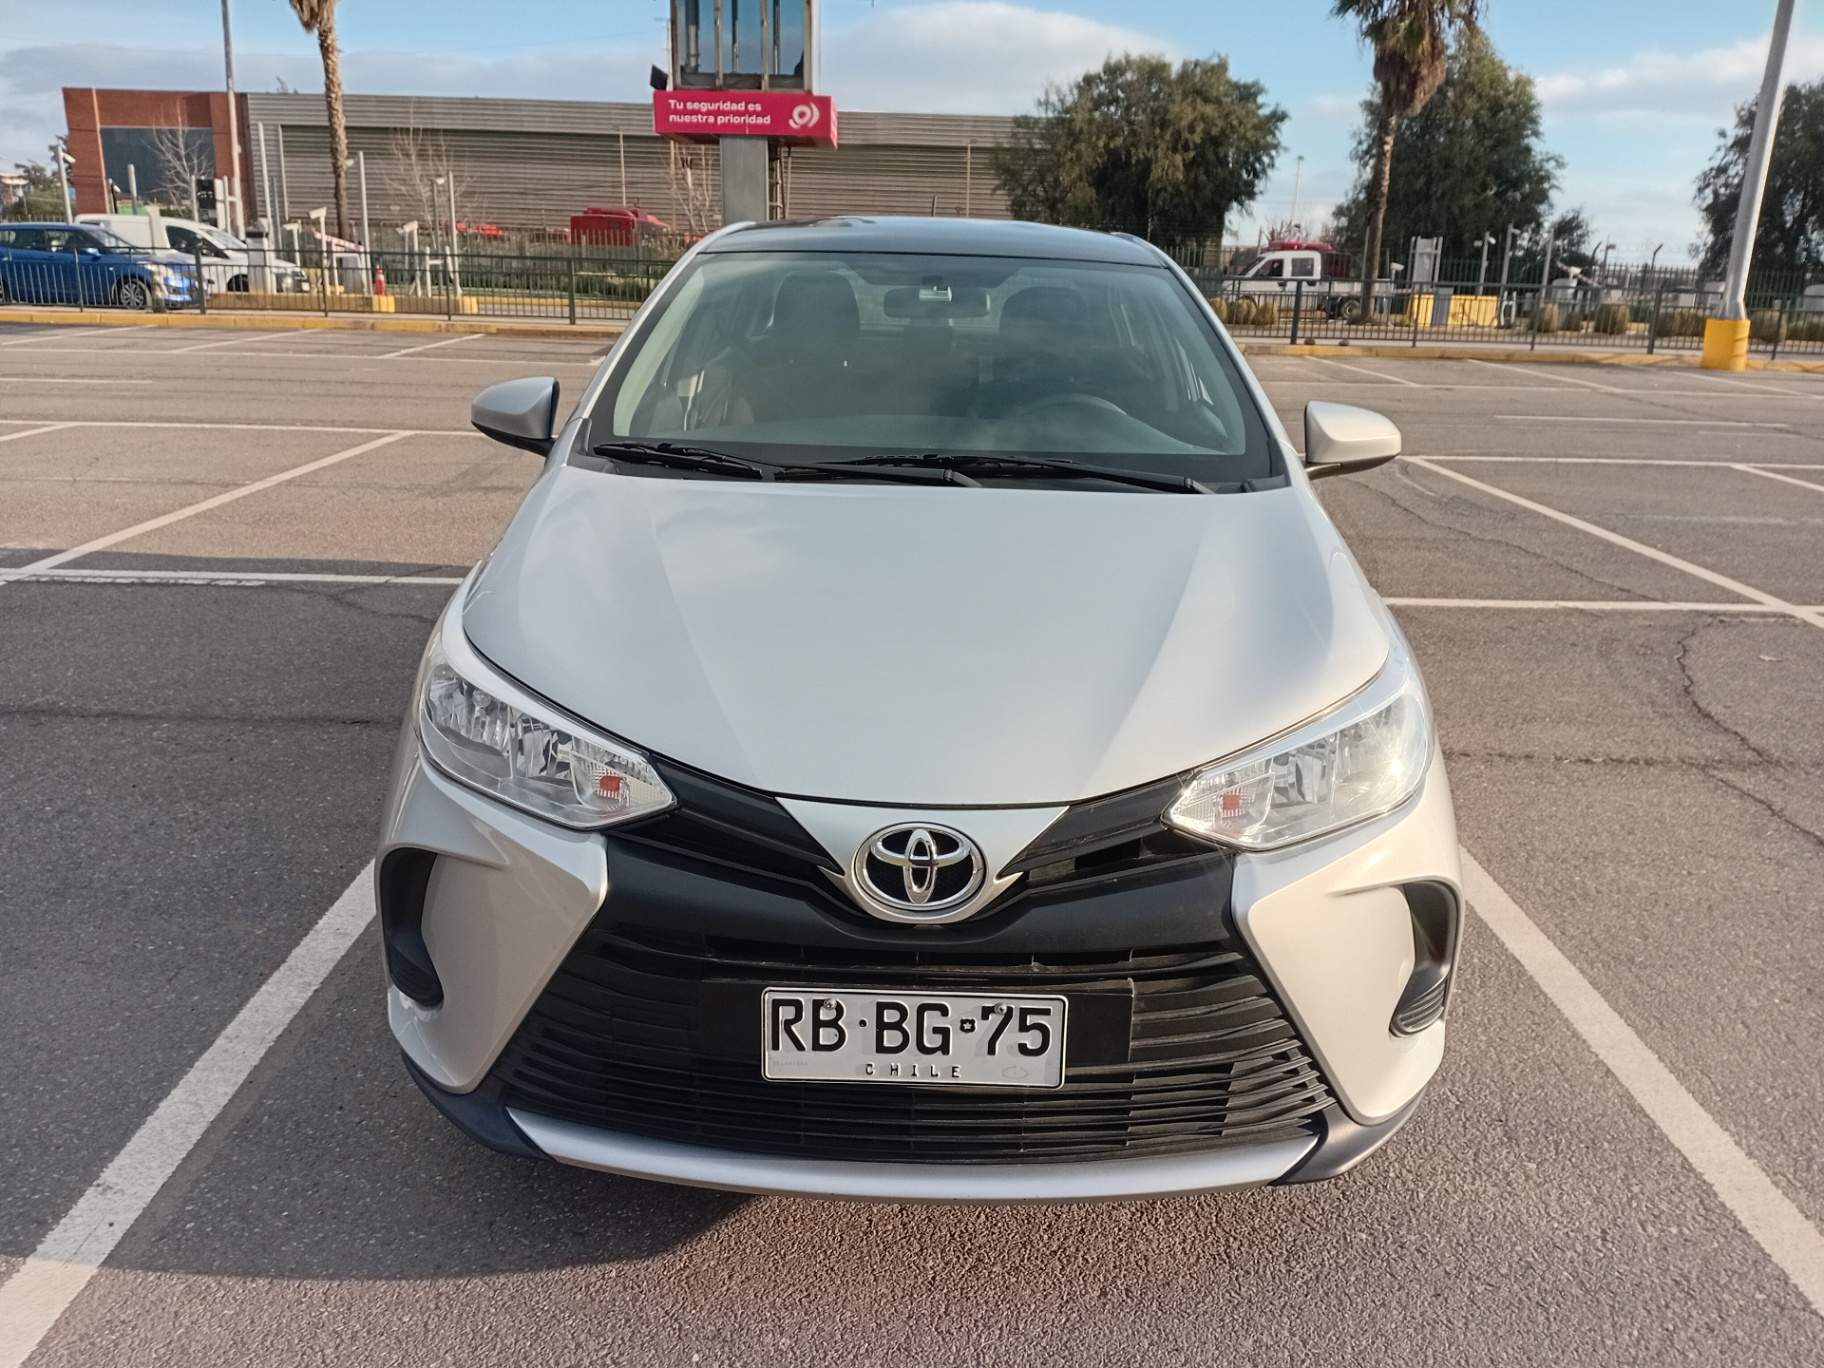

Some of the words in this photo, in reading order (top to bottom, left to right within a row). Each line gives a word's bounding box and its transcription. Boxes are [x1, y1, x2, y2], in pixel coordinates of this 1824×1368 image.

[668, 99, 684, 109] Tu
[686, 101, 745, 112] seguridad
[747, 103, 762, 111] es
[669, 114, 715, 122] nuestra
[717, 114, 771, 125] prioridad
[864, 1063, 962, 1078] CHILE
